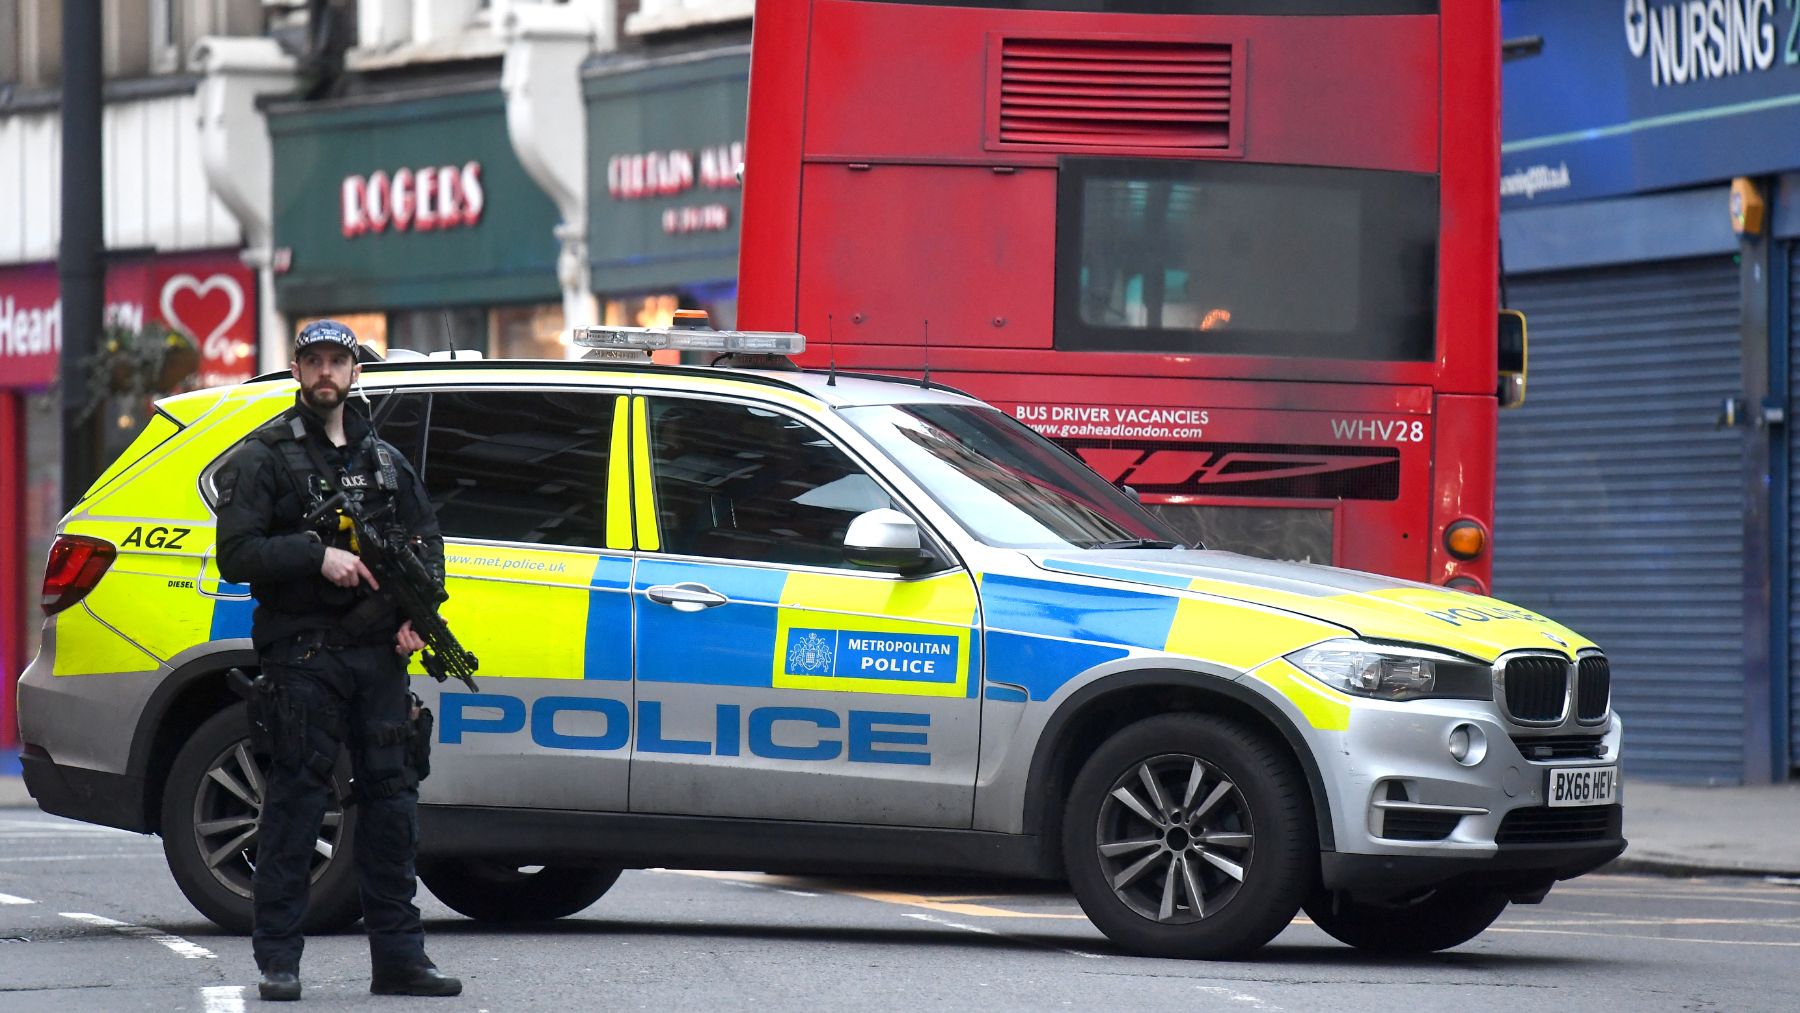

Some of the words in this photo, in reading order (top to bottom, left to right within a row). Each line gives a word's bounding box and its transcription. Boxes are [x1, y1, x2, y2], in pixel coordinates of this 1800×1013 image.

[1650, 0, 1775, 87] NURSING
[341, 160, 485, 238] ROGERS
[1016, 405, 1047, 420] BUS
[1052, 406, 1110, 422] DRIVER
[1115, 408, 1209, 425] VACANCIES
[1331, 418, 1424, 442] WHV28
[341, 474, 368, 487] OLICE
[120, 526, 191, 549] AGZ
[167, 580, 194, 589] DIESEL
[848, 638, 951, 656] METROPOLITAN
[861, 656, 935, 674] POLICE
[438, 692, 932, 766] POLICE
[1555, 772, 1591, 801] BX66
[1592, 770, 1613, 800] HEV
